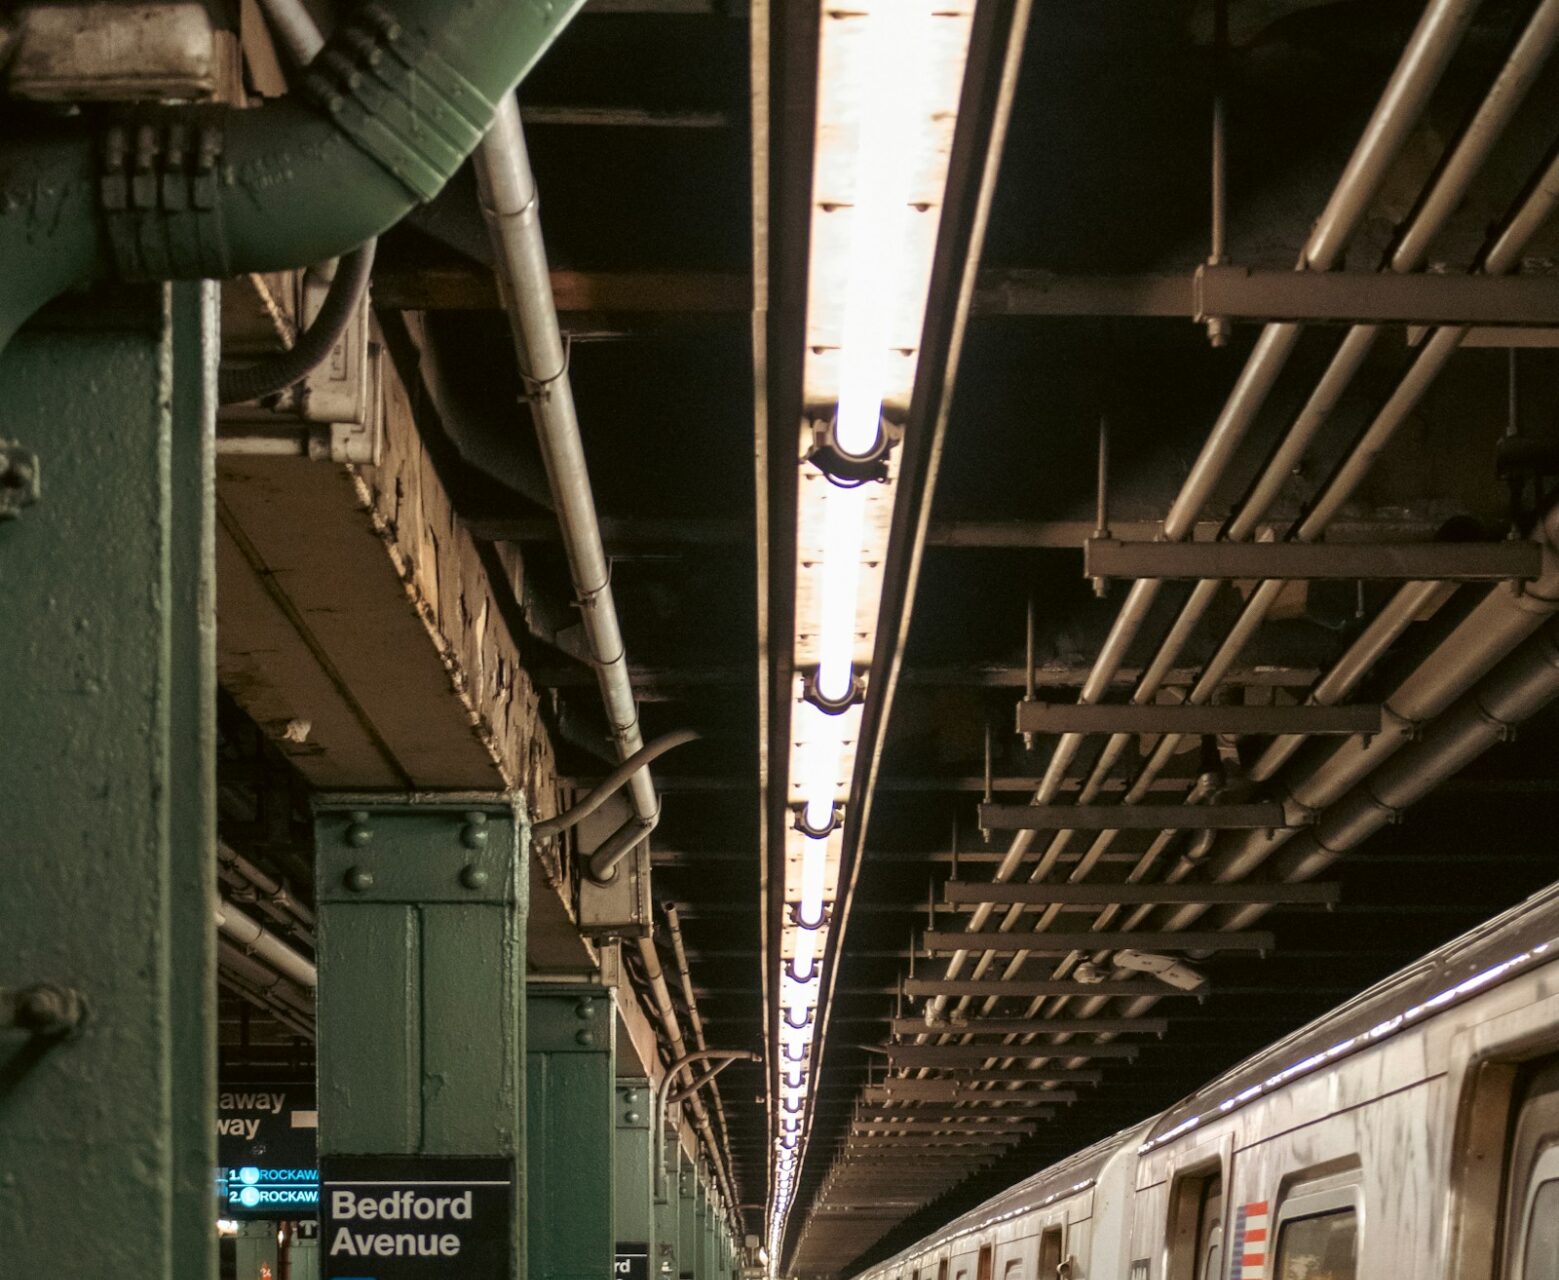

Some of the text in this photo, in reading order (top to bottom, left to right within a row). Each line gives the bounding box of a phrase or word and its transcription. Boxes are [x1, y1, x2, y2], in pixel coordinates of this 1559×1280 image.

[260, 1169, 319, 1181] ROCKAW
[260, 1190, 319, 1203] ROCKAW
[332, 1190, 473, 1220] Bedford
[329, 1227, 461, 1256] Avenue
